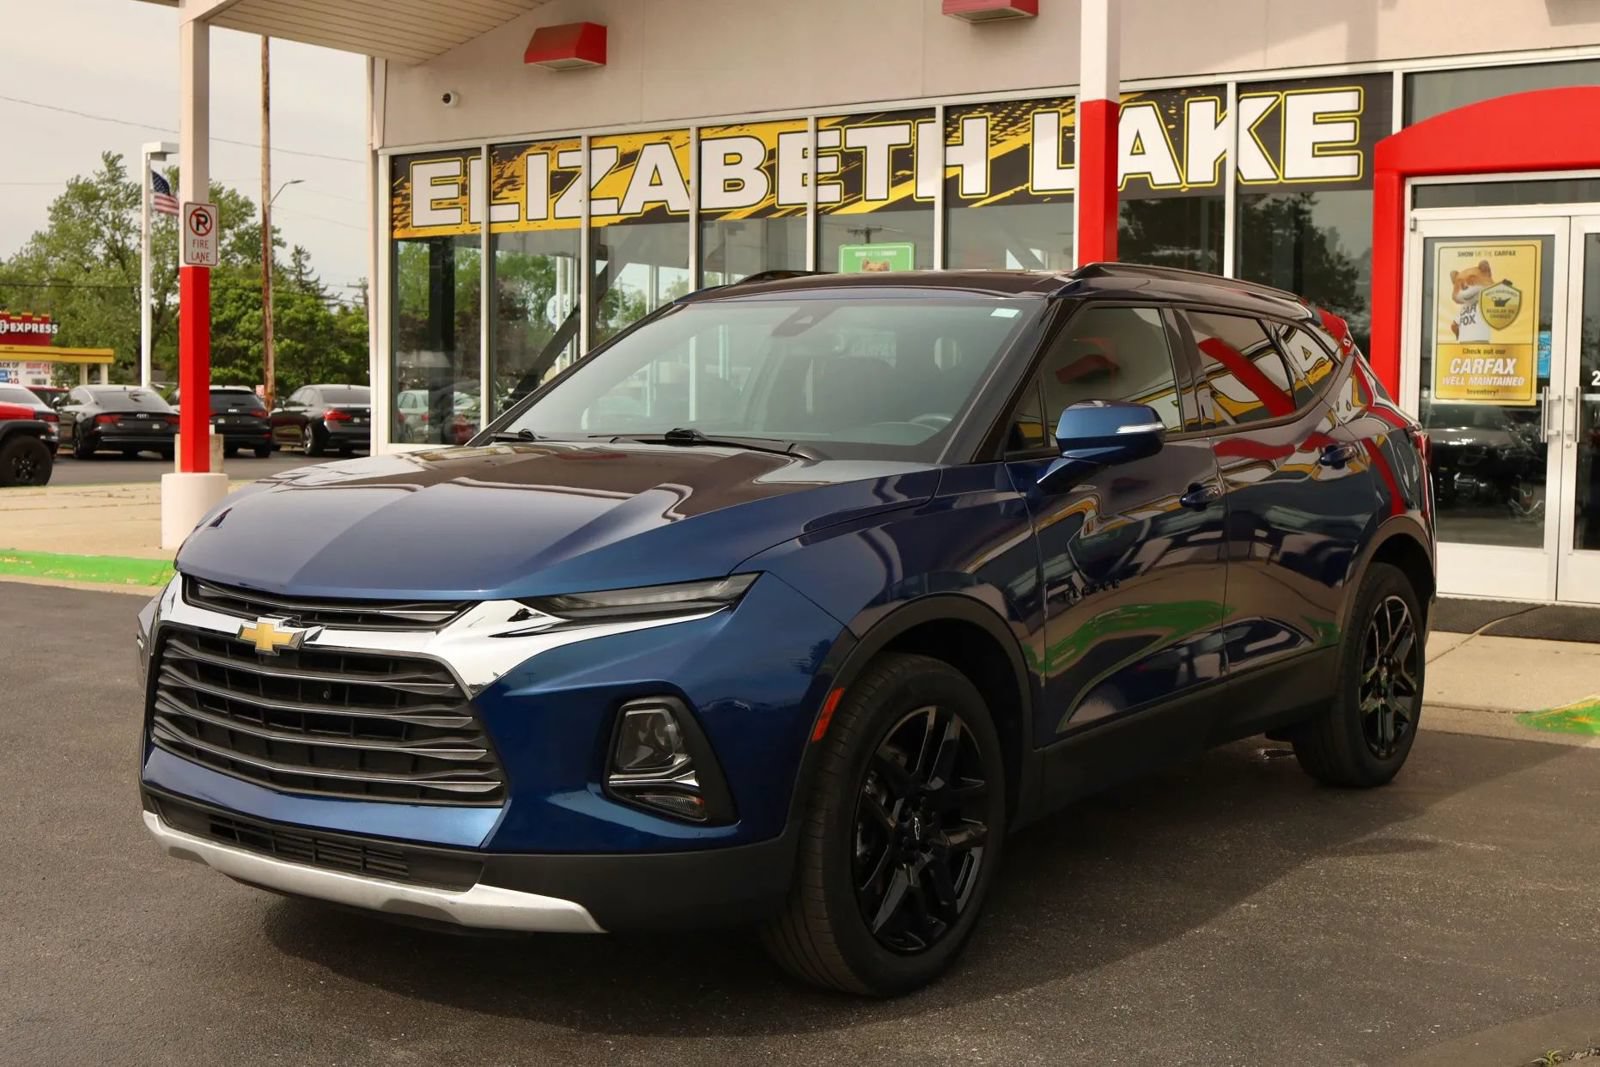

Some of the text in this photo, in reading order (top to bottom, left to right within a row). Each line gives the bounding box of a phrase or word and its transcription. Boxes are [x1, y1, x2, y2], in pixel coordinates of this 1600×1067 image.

[410, 87, 1363, 227] ELIZABETH LAKE
[192, 240, 209, 249] FIRE
[191, 251, 210, 262] LANE
[10, 322, 58, 334] EXPRESS
[1449, 358, 1517, 375] CARFAX
[1442, 376, 1525, 386] WELL MAINTAINED
